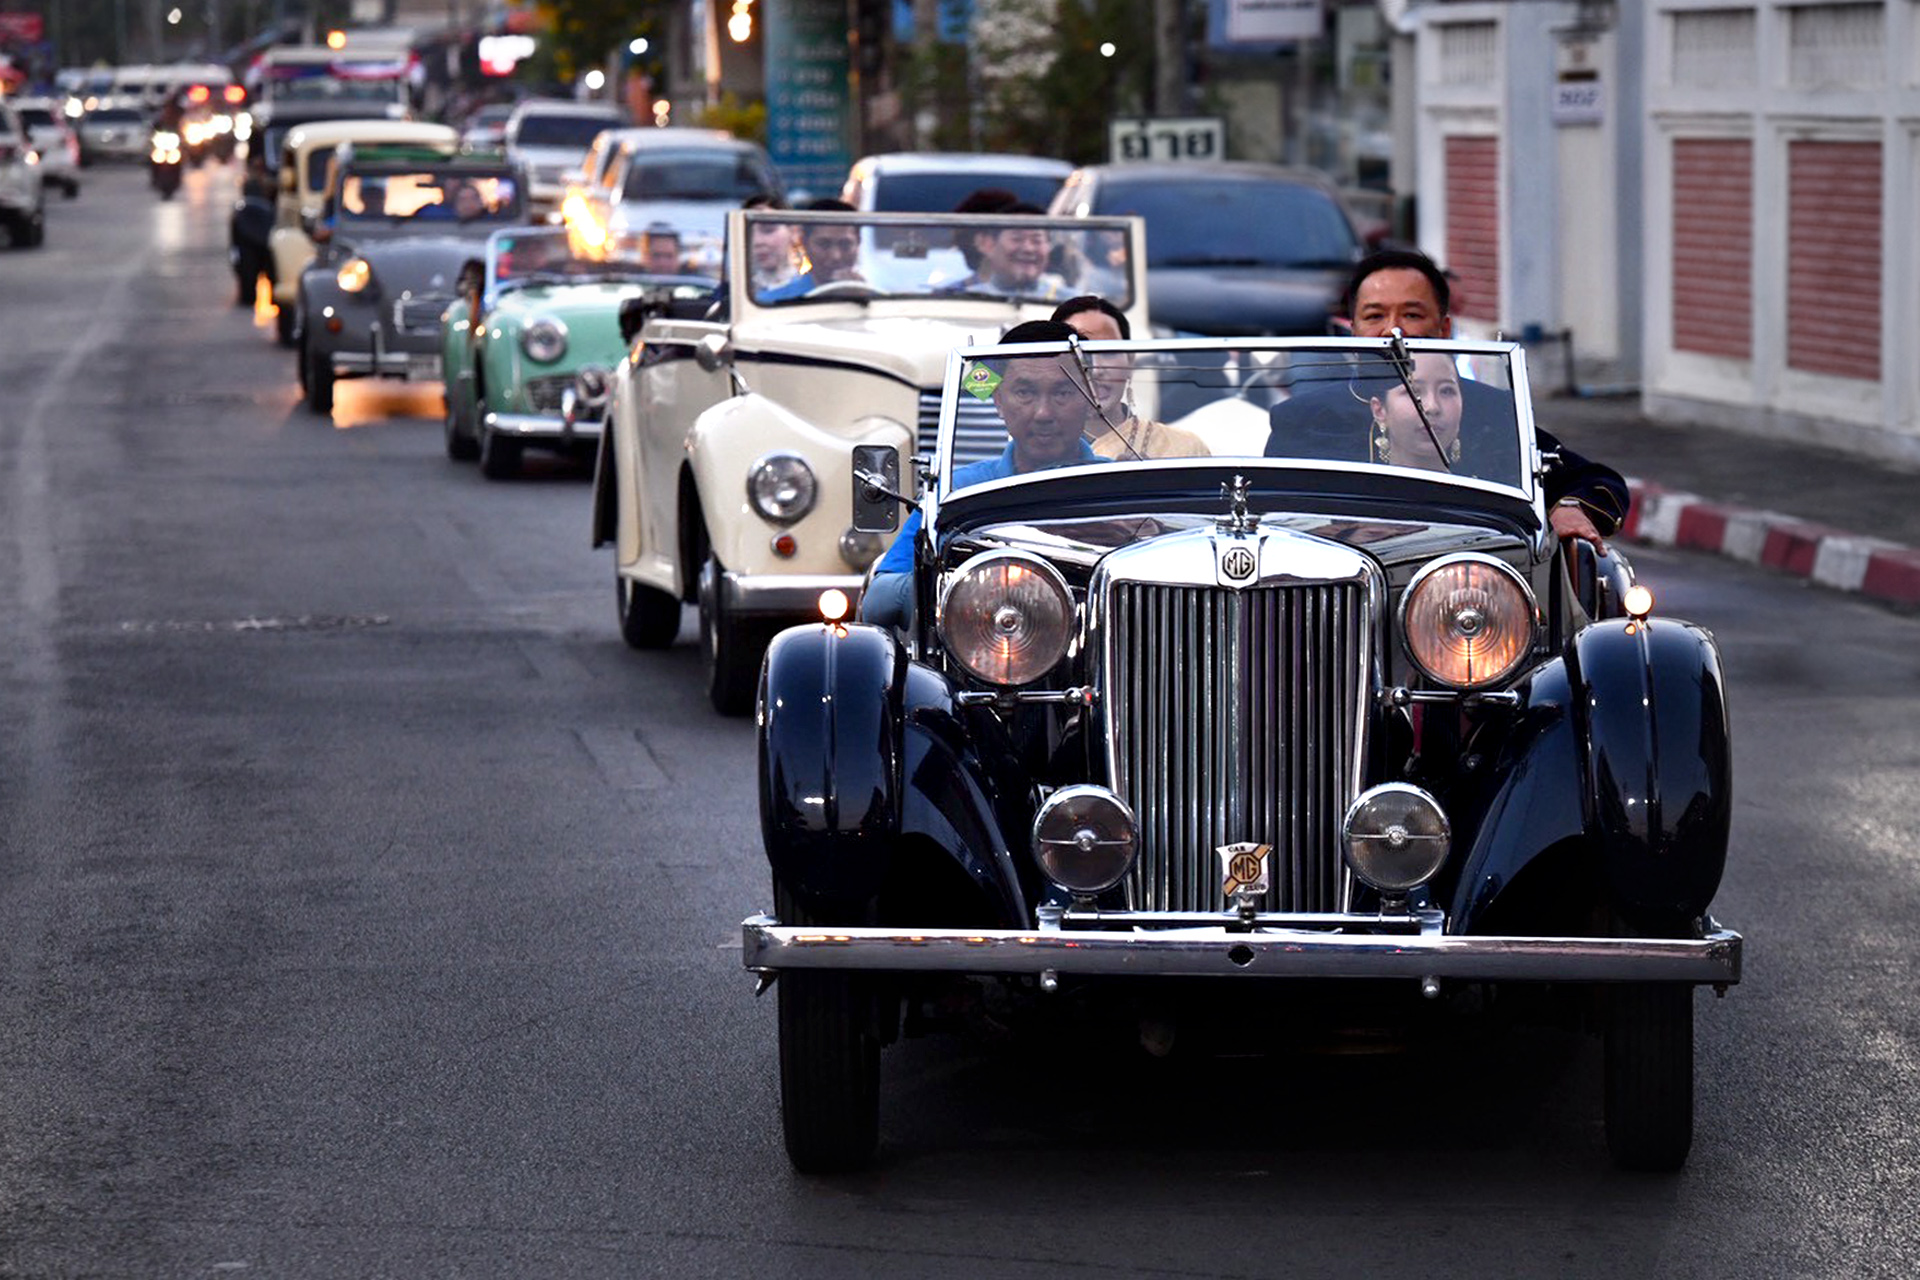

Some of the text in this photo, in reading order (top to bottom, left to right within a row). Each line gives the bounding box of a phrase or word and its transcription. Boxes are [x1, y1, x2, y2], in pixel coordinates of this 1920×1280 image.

[1120, 120, 1214, 159] ถ่าย
[1227, 551, 1251, 575] MG
[1228, 845, 1246, 853] CAR
[1233, 856, 1258, 880] MG
